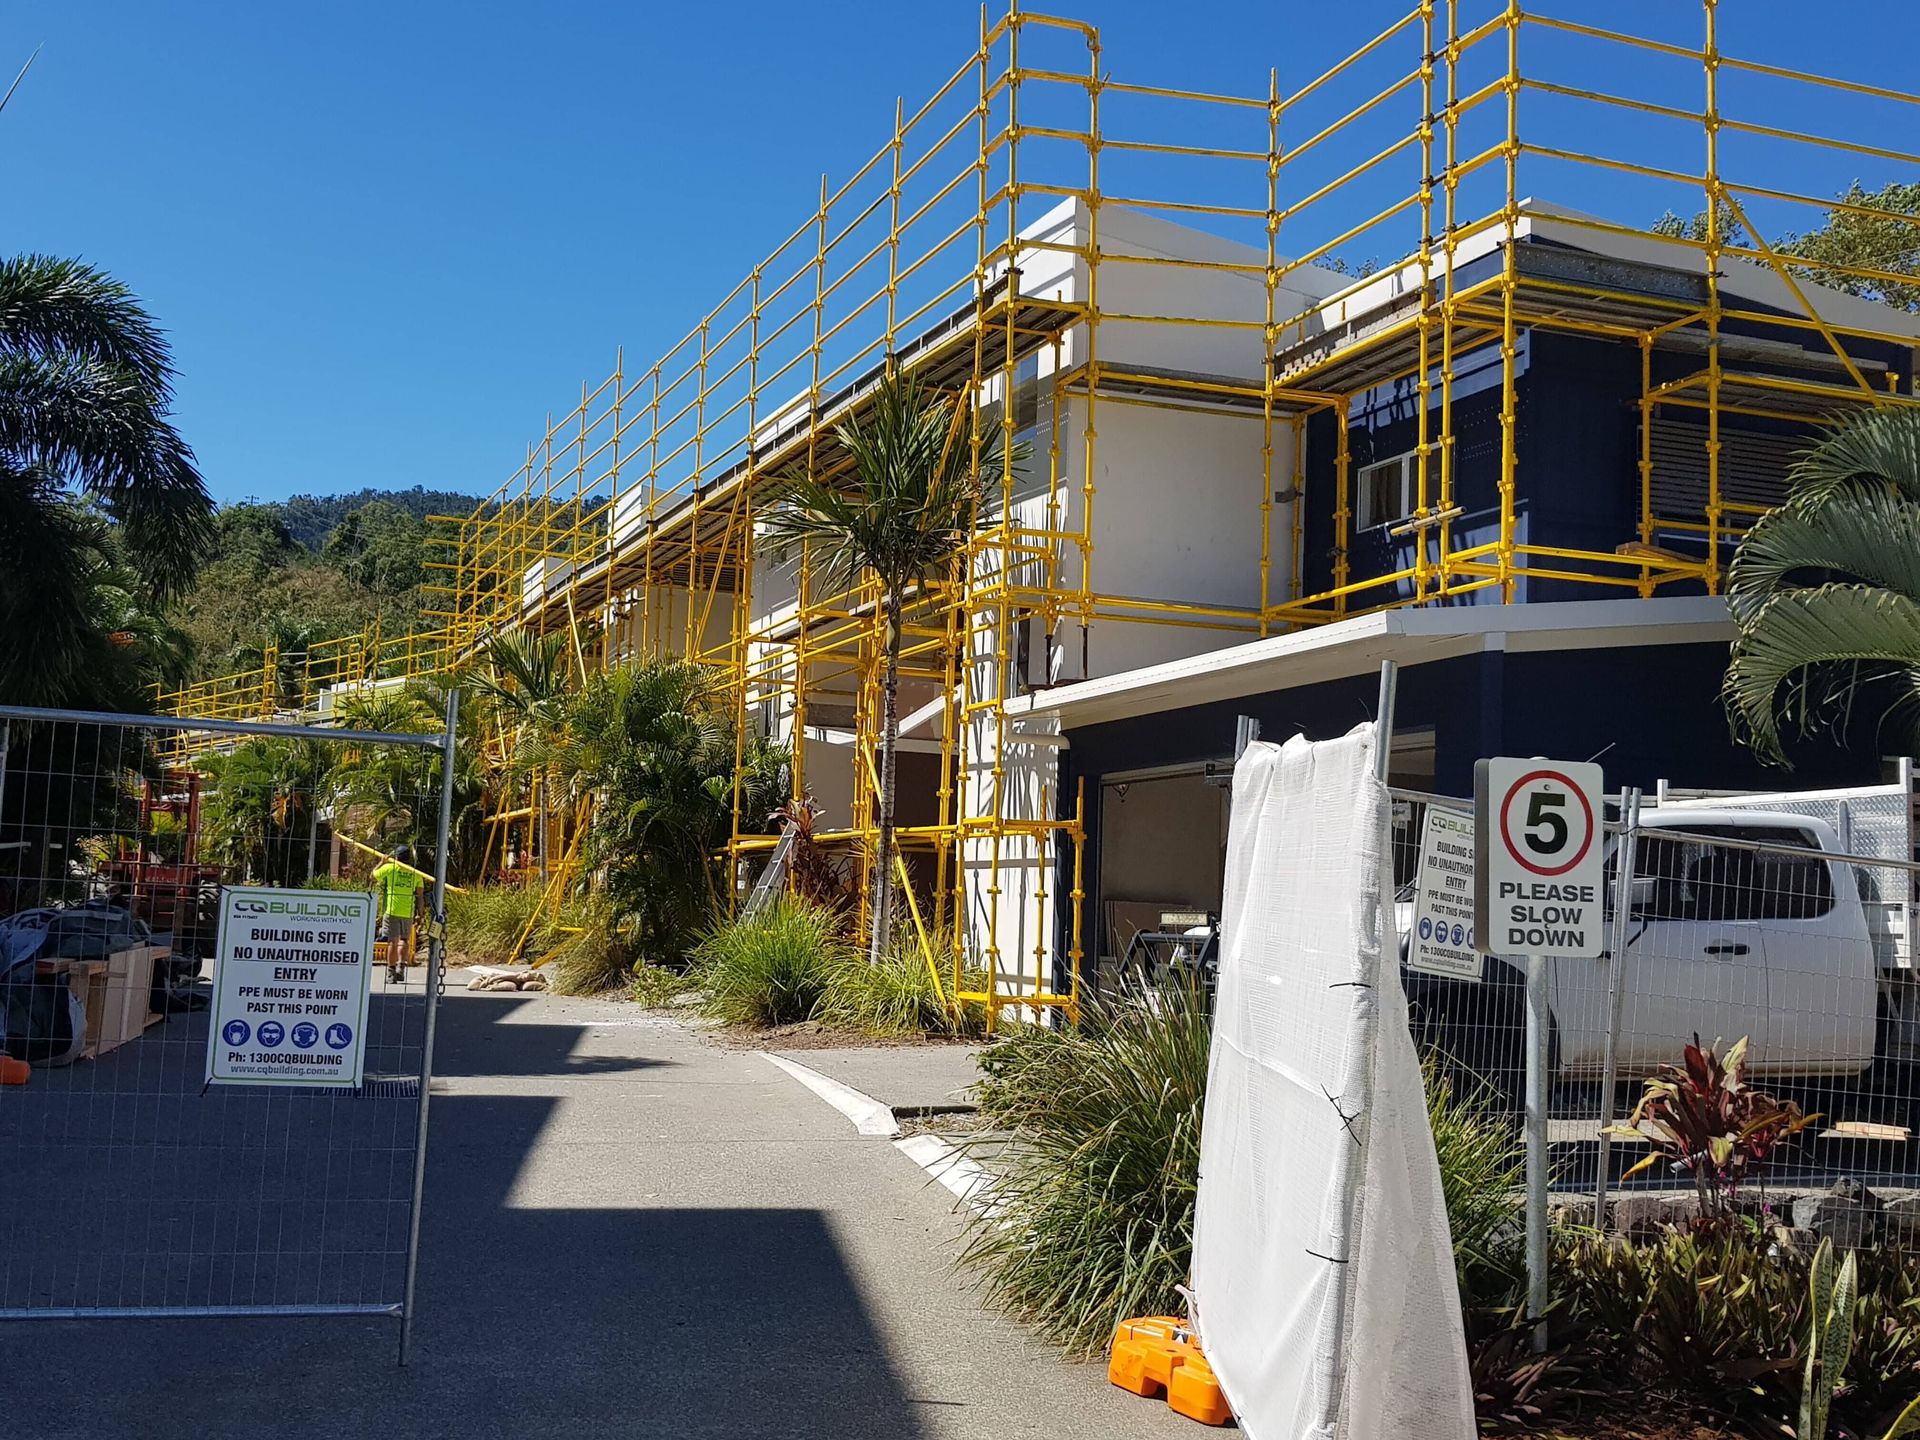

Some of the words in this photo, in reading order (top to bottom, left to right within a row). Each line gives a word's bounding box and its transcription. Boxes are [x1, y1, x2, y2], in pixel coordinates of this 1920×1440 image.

[1524, 791, 1568, 855] 5
[1436, 841, 1467, 858] BUILDING
[1427, 855, 1438, 867] NO
[1439, 857, 1474, 874] UNAUTHOR
[1445, 875, 1467, 889] ENTRY
[1427, 889, 1439, 900] PPE
[1439, 891, 1455, 903] MUST
[1455, 895, 1463, 905] BE
[1463, 897, 1474, 907] WO
[1499, 881, 1594, 903] PLEASE
[1431, 903, 1446, 914] PAST
[1445, 906, 1458, 917] THIS
[1510, 905, 1583, 925] SLOW
[290, 915, 320, 923] WORKING
[321, 916, 338, 924] WITH
[250, 928, 314, 943] BUILDING
[317, 931, 347, 945] SITE
[1508, 928, 1584, 948] DOWN
[233, 946, 253, 959] NO
[257, 947, 360, 964] UNAUTHORISED
[273, 966, 318, 981] ENTRY
[238, 986, 261, 997] PPE
[263, 987, 295, 999] MUST
[298, 988, 313, 999] BE
[315, 989, 348, 1001] WORN
[246, 1002, 275, 1013] PAST
[277, 1003, 302, 1014] THIS
[305, 1004, 338, 1016] POINT
[228, 1051, 246, 1062] Ph:
[249, 1052, 343, 1065] 1300CQBUILDING
[230, 1065, 339, 1076] www.cqbuilding.com.au
